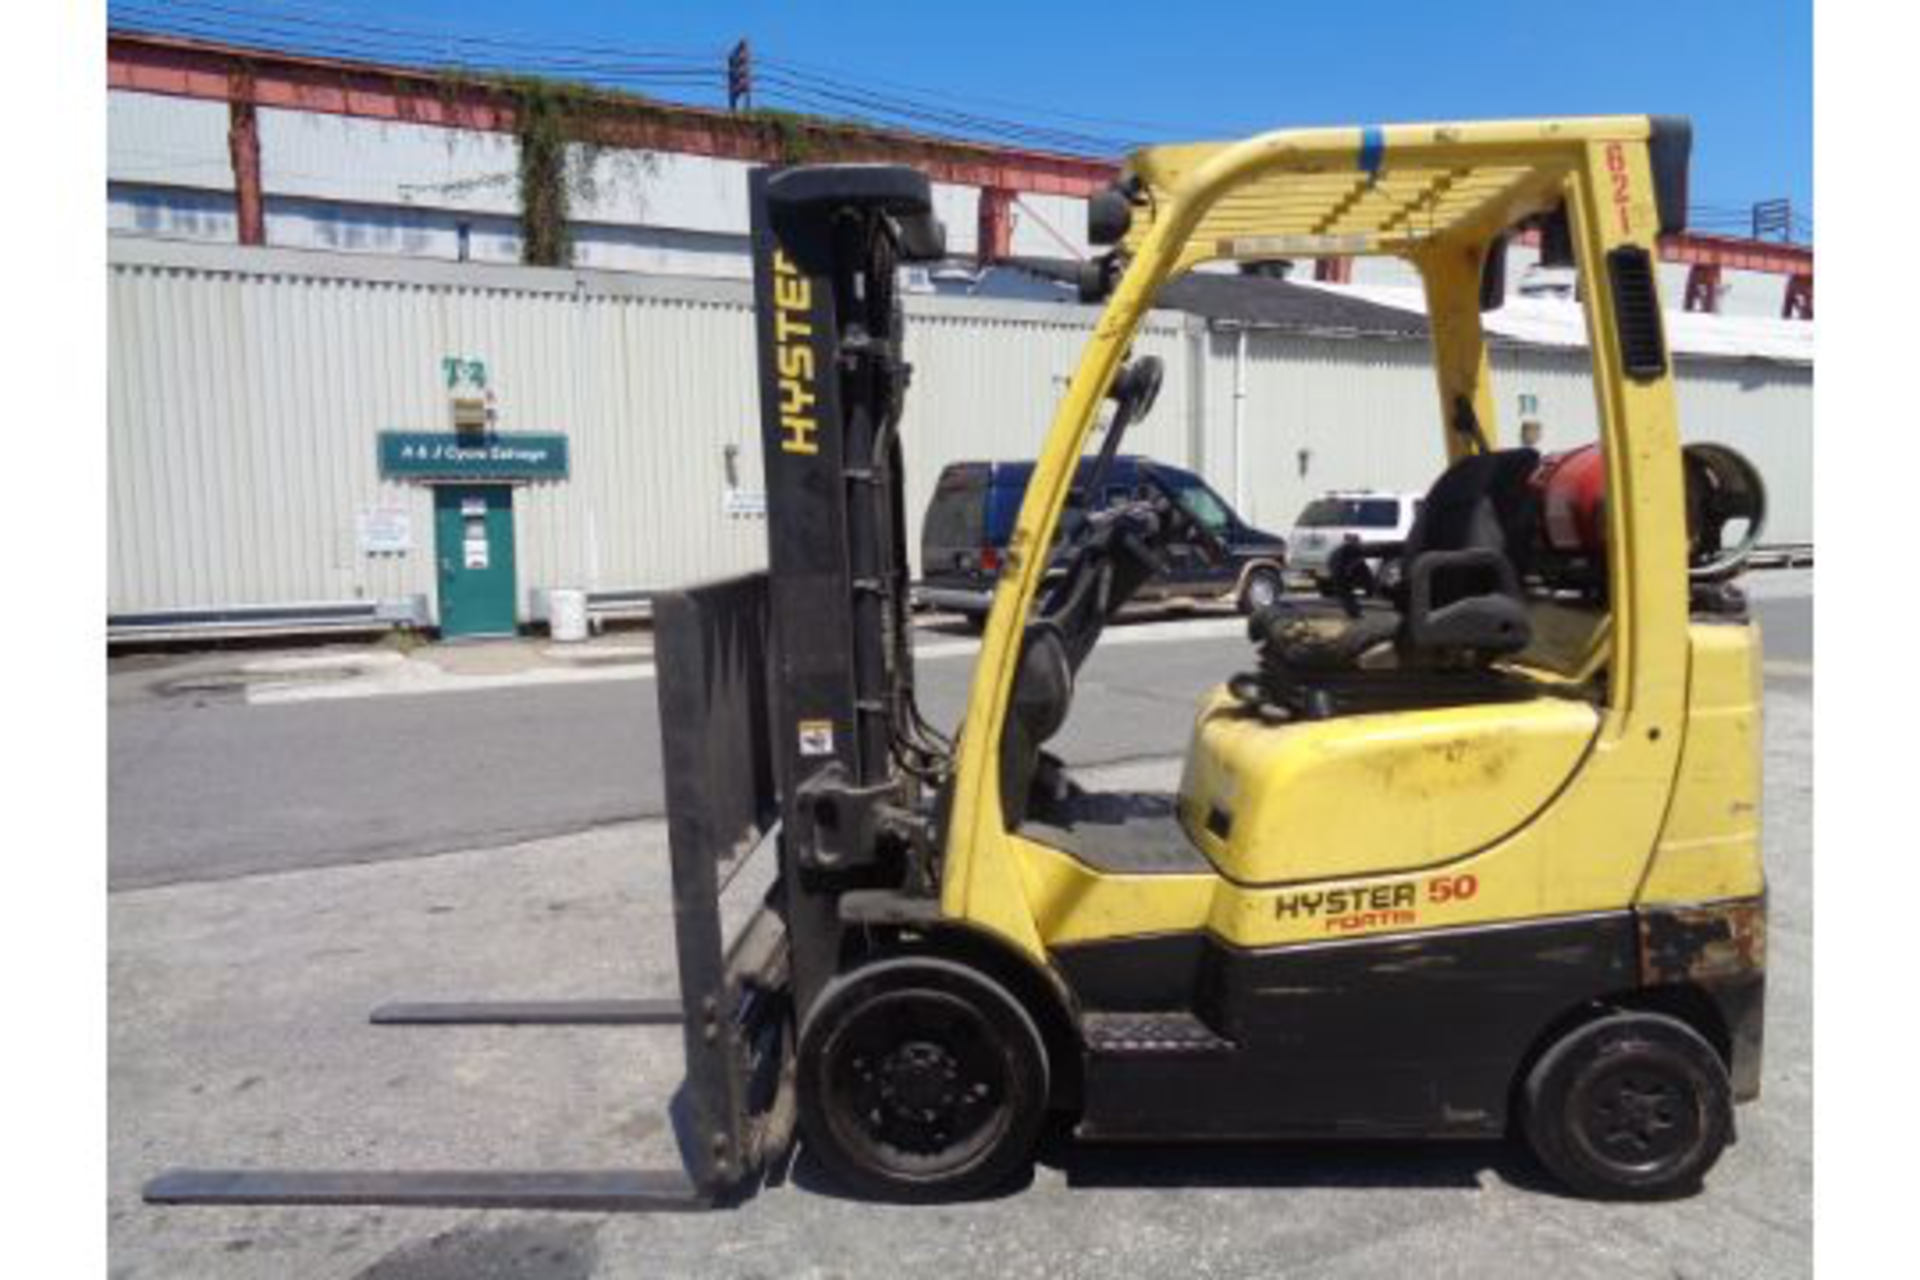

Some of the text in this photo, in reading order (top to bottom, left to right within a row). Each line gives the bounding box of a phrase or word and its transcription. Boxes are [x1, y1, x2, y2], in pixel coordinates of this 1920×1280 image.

[1276, 875, 1478, 919] HYSTER 50
[1325, 910, 1417, 932] FORTIS
